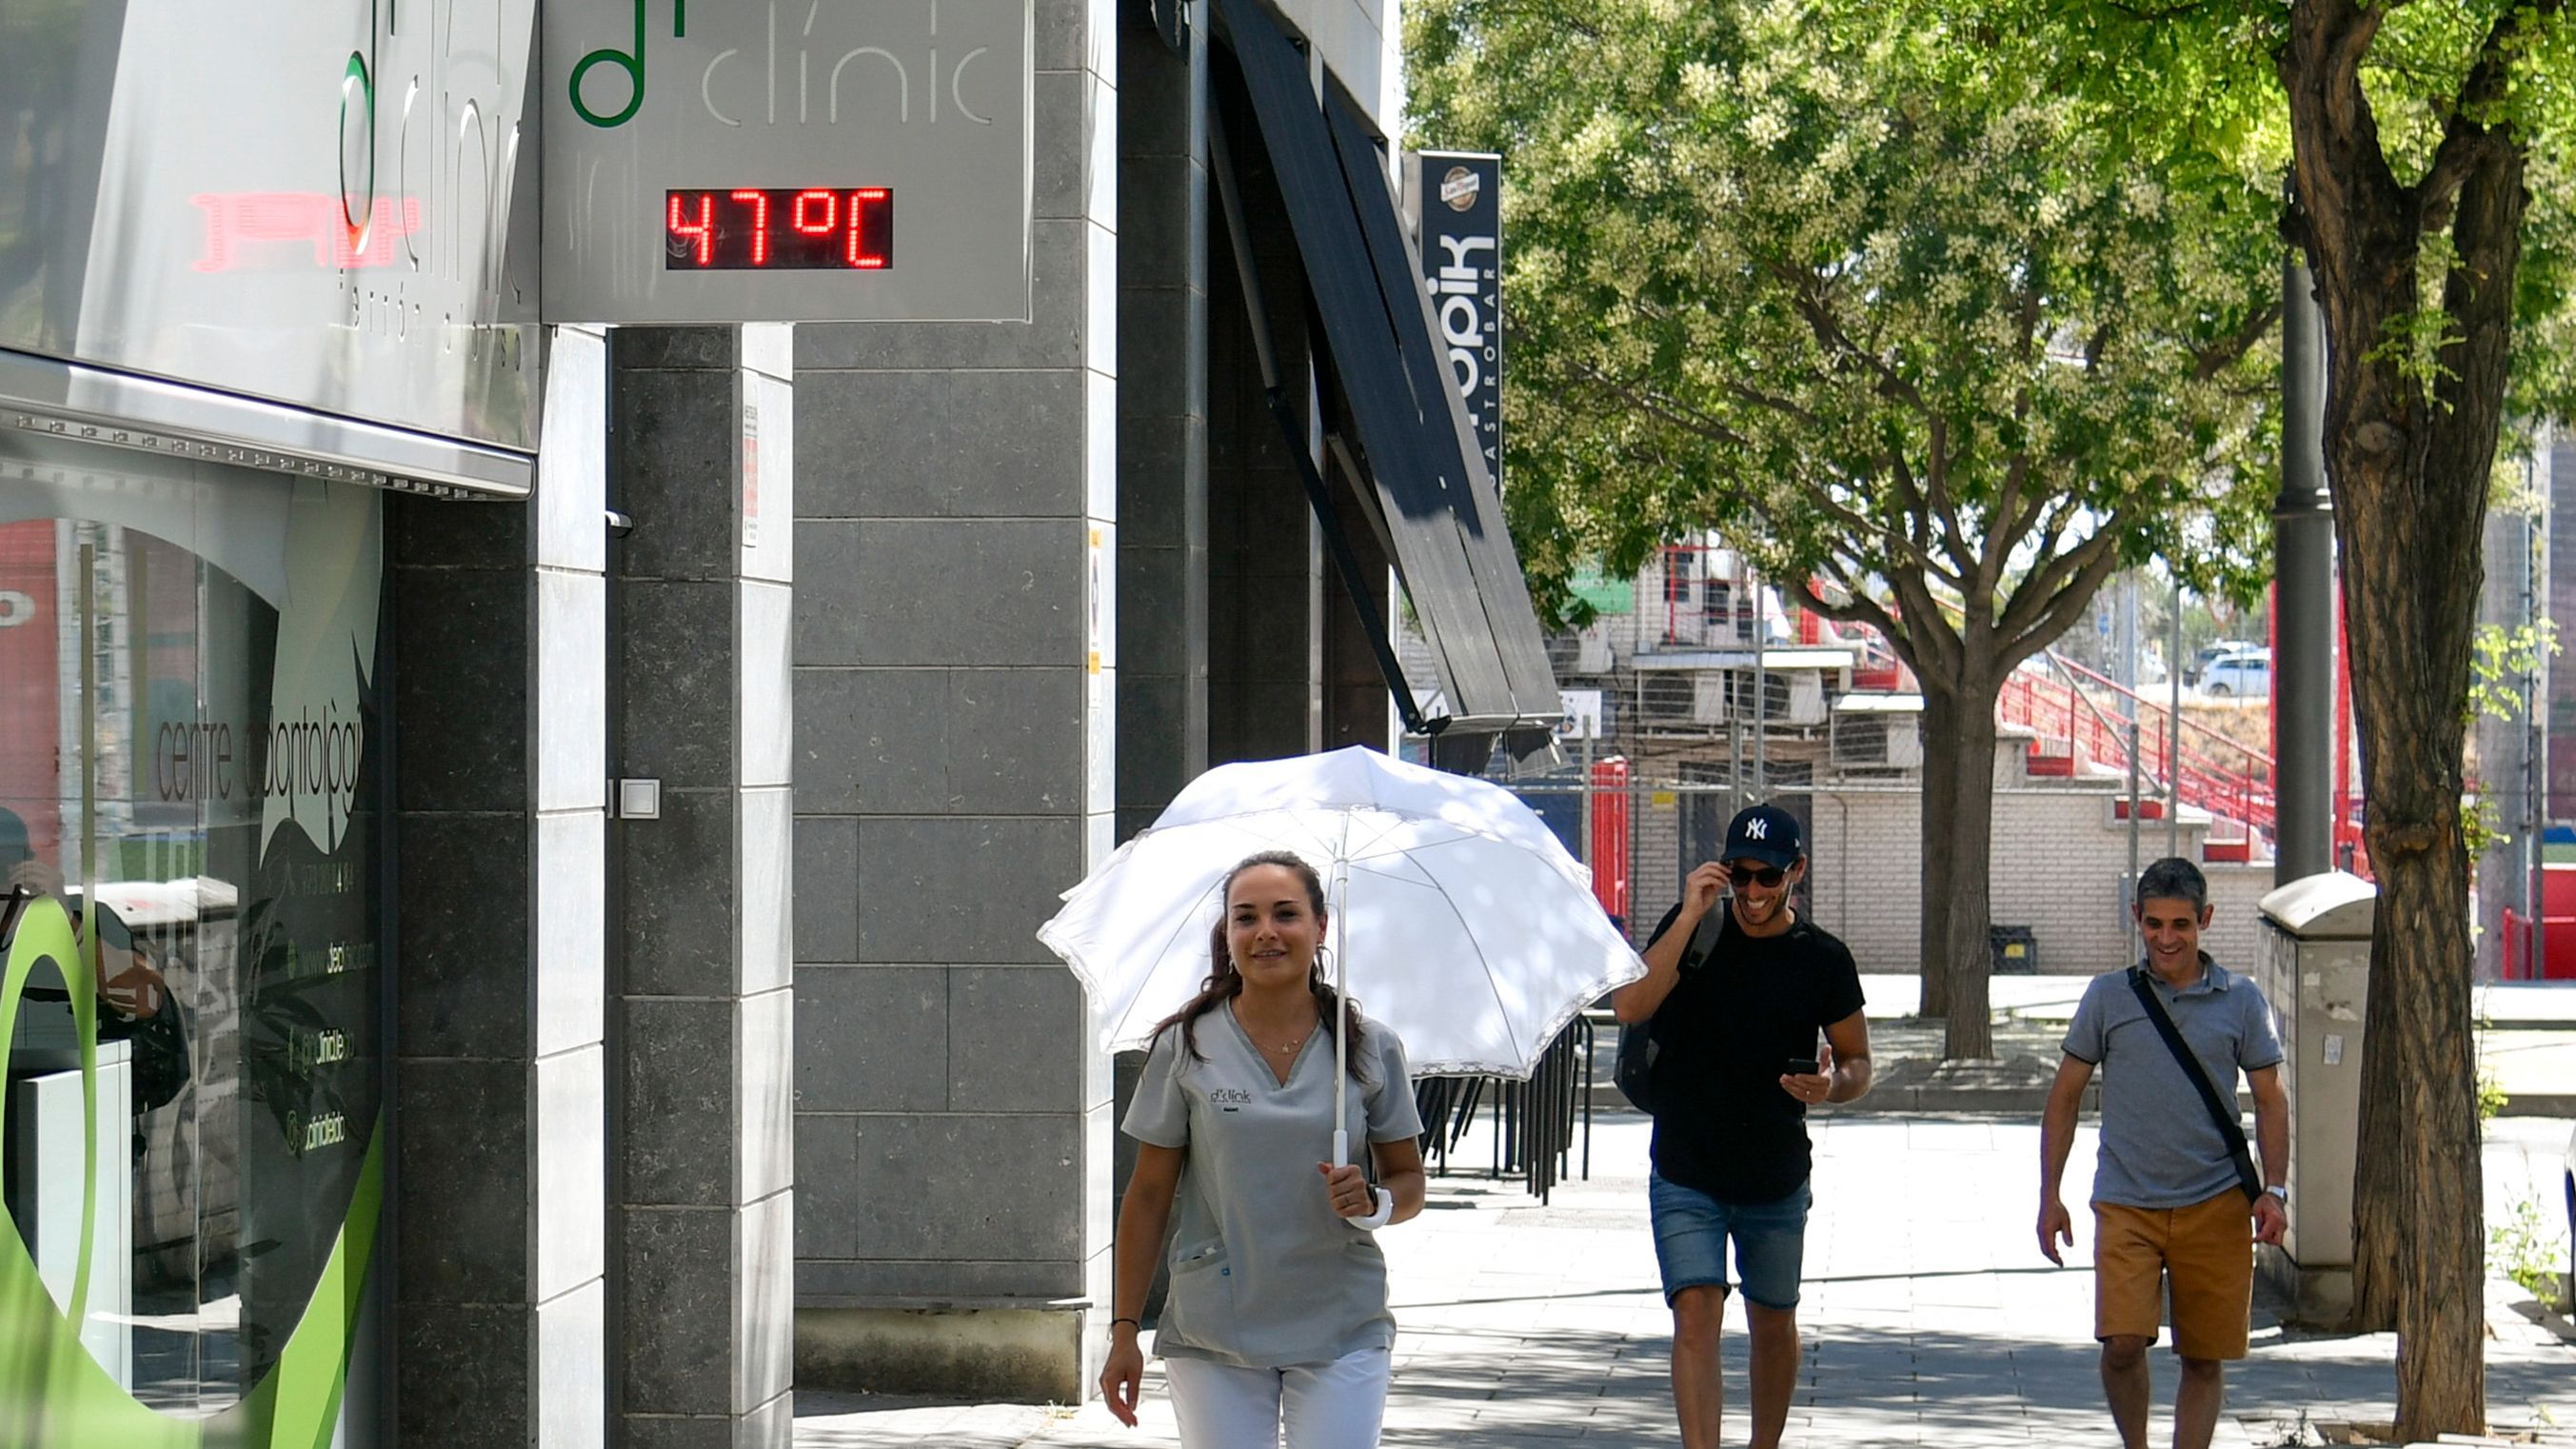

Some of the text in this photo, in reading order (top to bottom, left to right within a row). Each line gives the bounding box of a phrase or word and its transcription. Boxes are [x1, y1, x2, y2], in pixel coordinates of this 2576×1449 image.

[1427, 235, 1495, 426] opik
[157, 705, 232, 802] centre
[1745, 817, 1768, 840] NY
